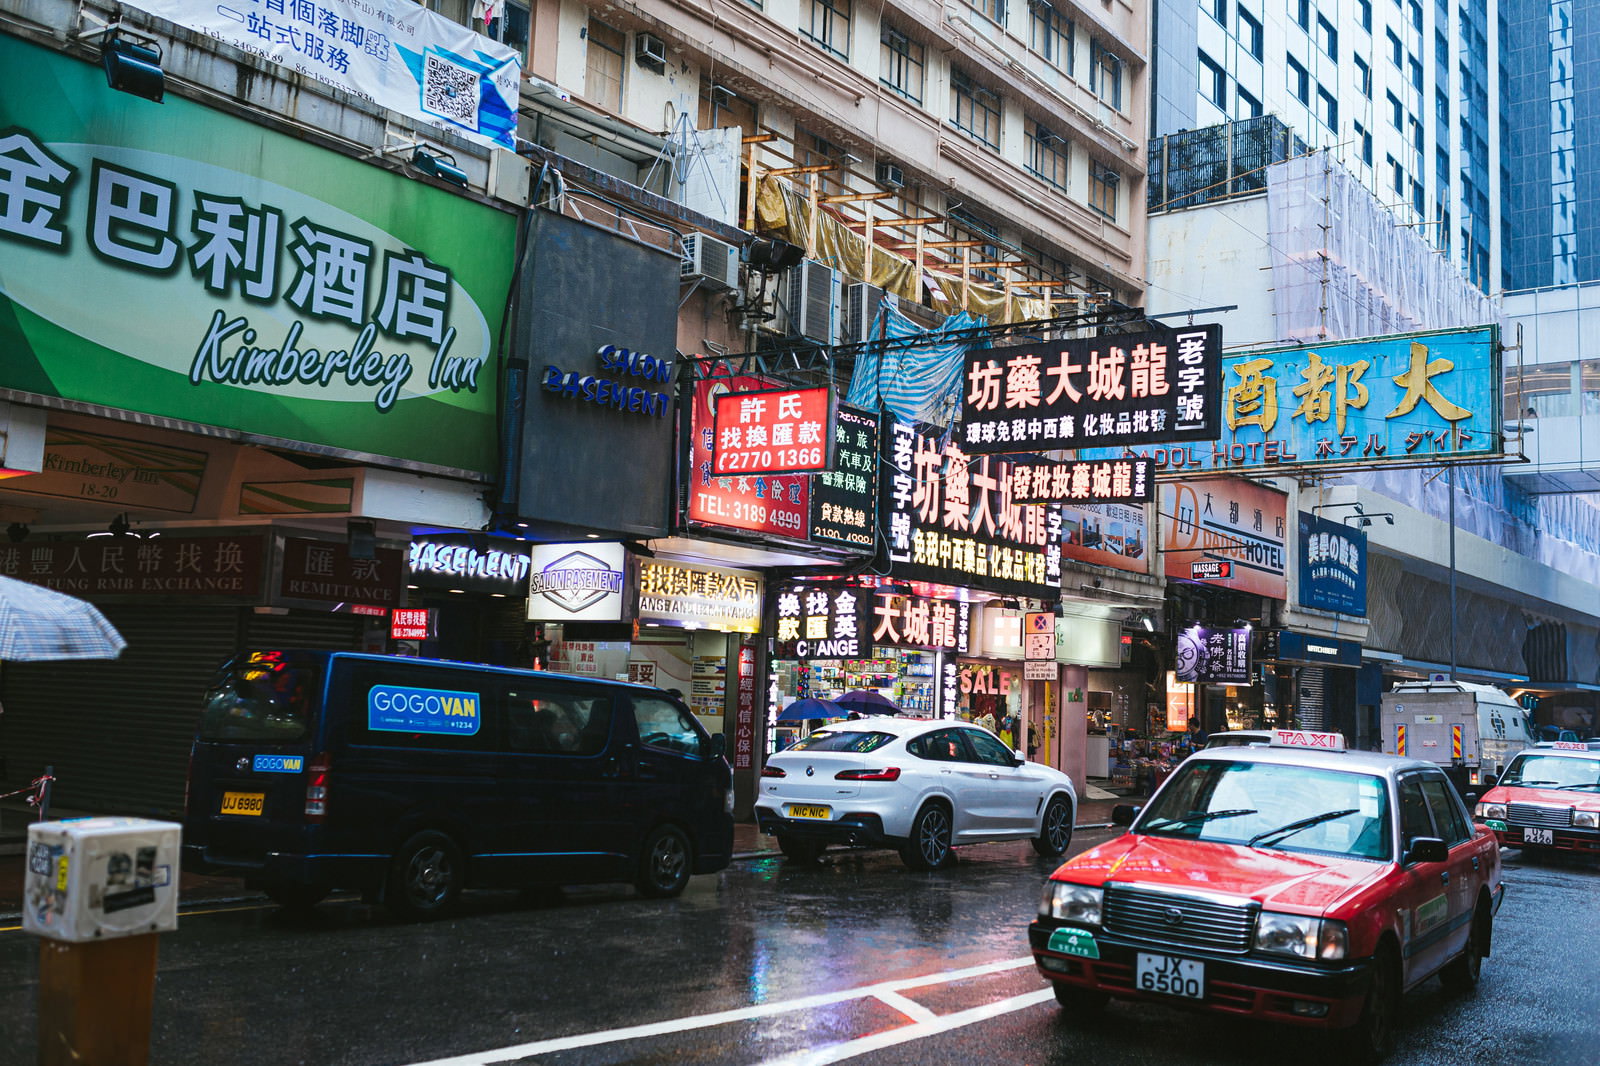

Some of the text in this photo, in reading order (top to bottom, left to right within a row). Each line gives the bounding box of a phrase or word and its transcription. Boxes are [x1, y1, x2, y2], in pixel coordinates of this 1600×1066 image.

[0, 132, 450, 345] 金巴利酒店
[190, 309, 482, 410] Kimberley Inn
[600, 344, 672, 383] SALON
[545, 365, 670, 417] BASEMENT
[740, 393, 803, 424] 許氏
[720, 421, 822, 450] 找換匯款
[729, 448, 821, 470] 2770 1366
[1212, 439, 1297, 464] HOTEL
[43, 452, 161, 485] Kimberley Inn
[79, 482, 119, 499] 18-20
[698, 492, 731, 518] TEL:
[734, 502, 767, 523] 3189
[1203, 492, 1285, 539] 大都酒店
[1246, 537, 1285, 570] HOTEL
[1193, 562, 1219, 574] MASSAGE
[47, 577, 89, 591] FUNG
[97, 577, 134, 590] RMB
[142, 577, 244, 591] EXCHANGE
[289, 579, 393, 600] REMITTANCE
[532, 569, 621, 593] SALON BASEMENT
[1045, 636, 1050, 644] 7
[1045, 648, 1050, 656] 7
[960, 668, 1011, 696] SALE
[374, 692, 475, 717] GOGOVAN
[1277, 731, 1336, 748] TAXI
[1555, 742, 1585, 750] TAXI
[255, 757, 301, 770] GOGOVAN
[223, 797, 262, 811] UJ 6980
[793, 807, 824, 817] NIC NIC
[1532, 828, 1544, 836] UZ
[1058, 944, 1089, 955] SEATS
[1068, 936, 1079, 946] 4
[1154, 956, 1183, 976] JX
[1141, 972, 1200, 996] 6500
